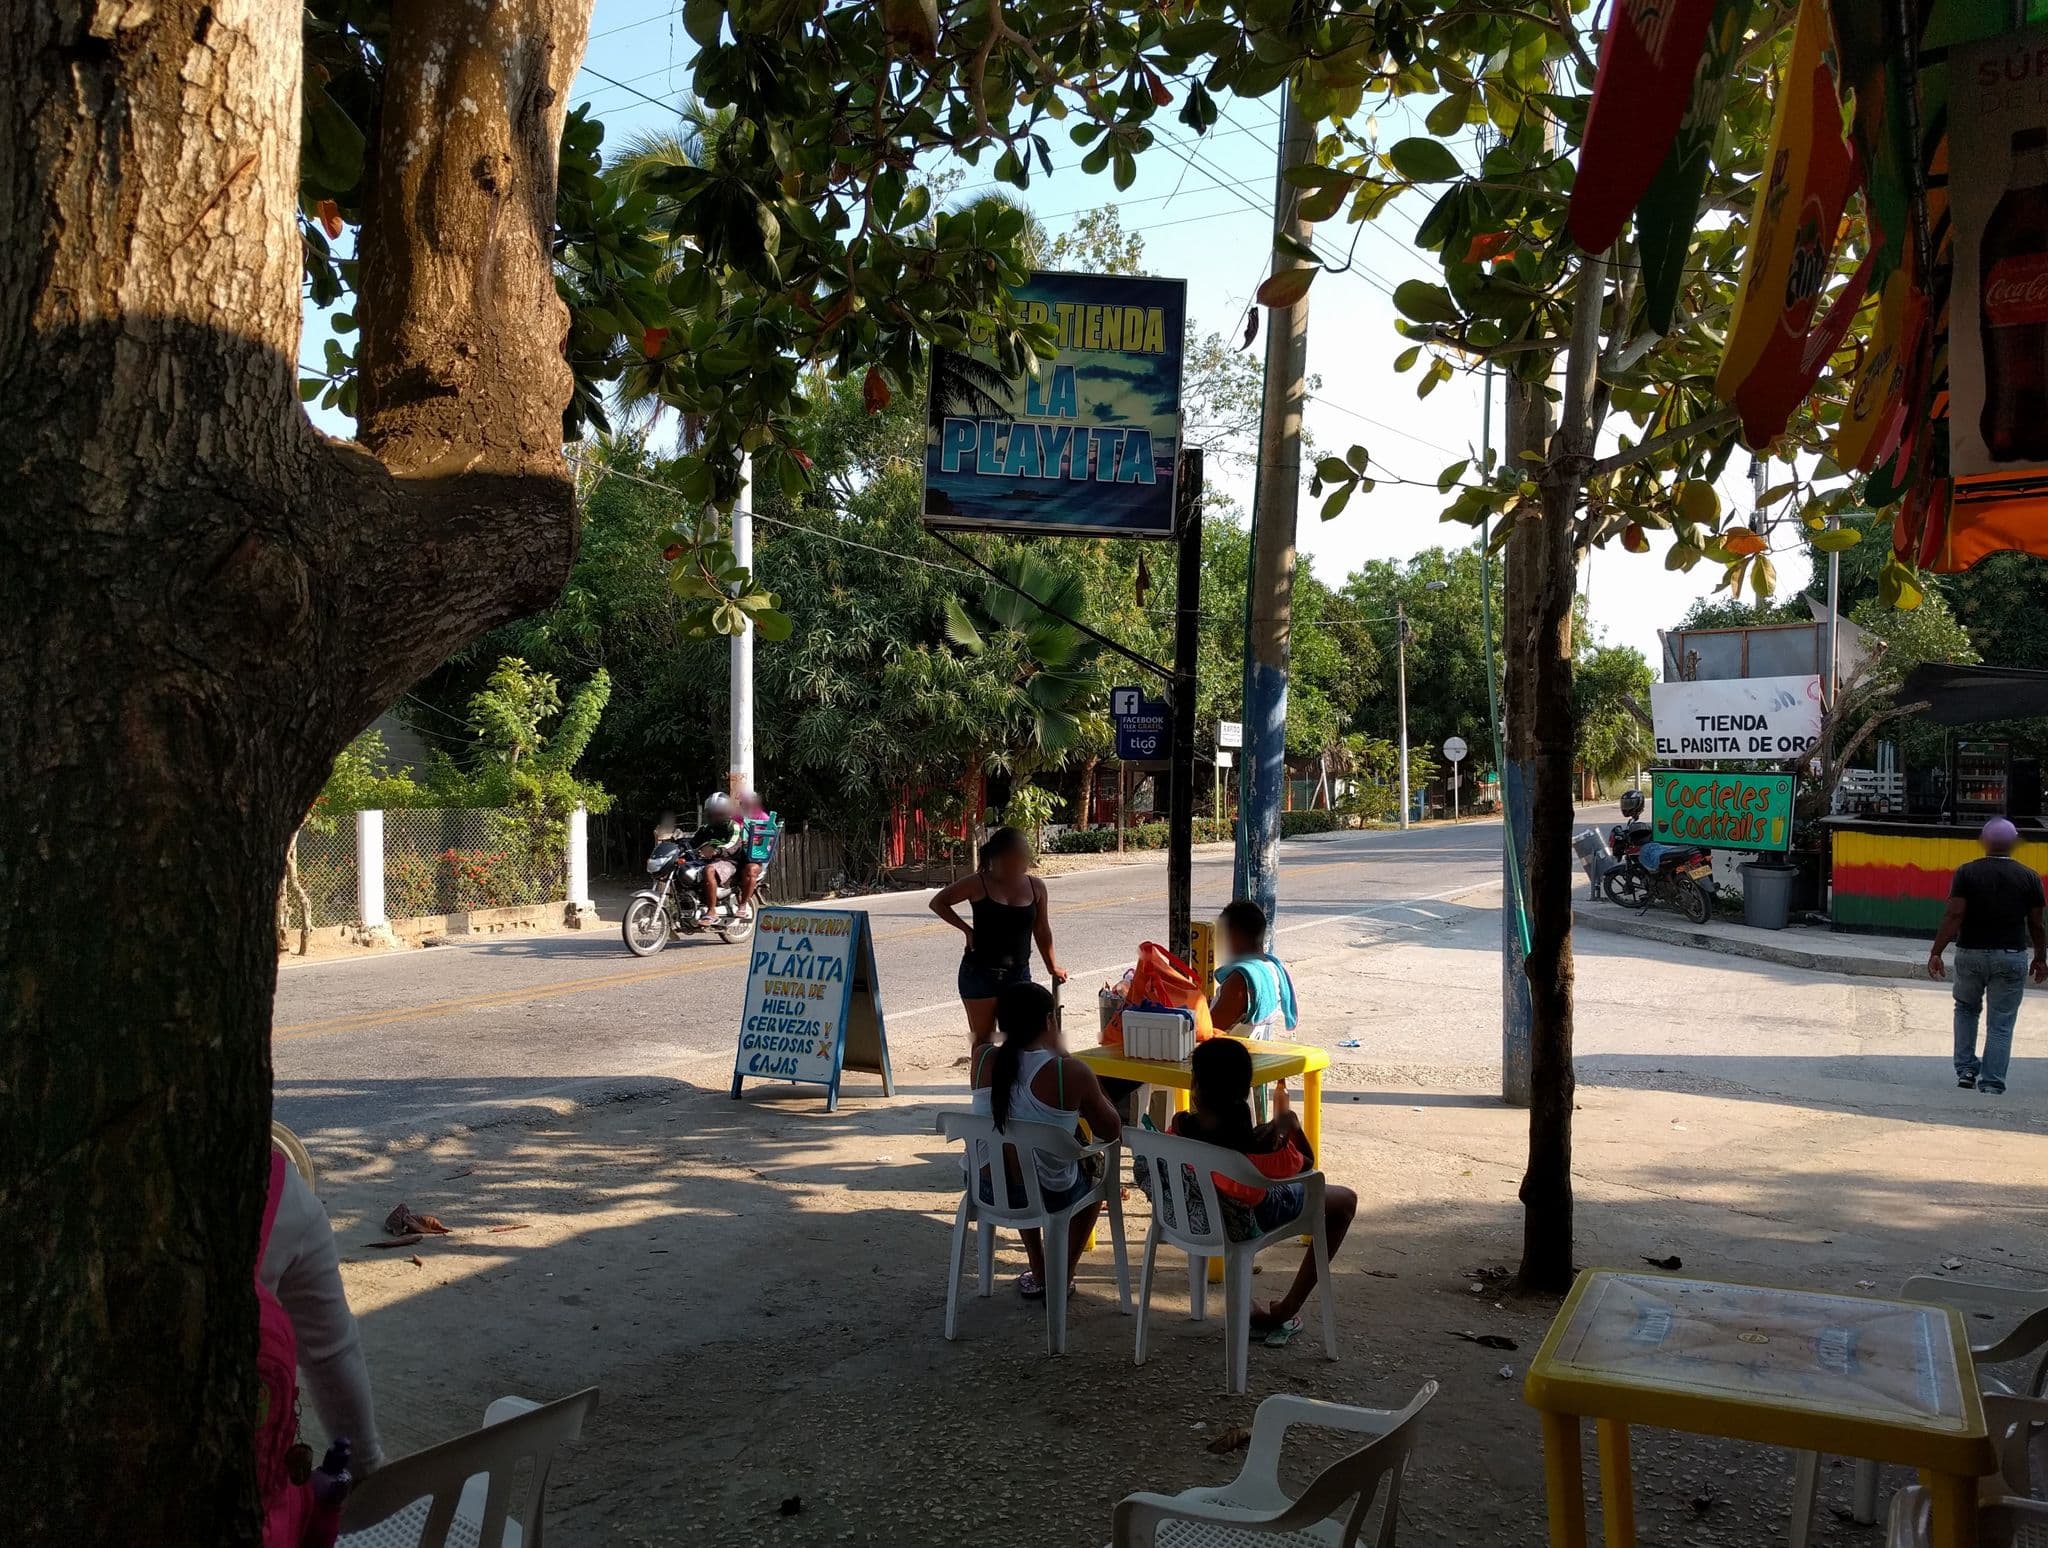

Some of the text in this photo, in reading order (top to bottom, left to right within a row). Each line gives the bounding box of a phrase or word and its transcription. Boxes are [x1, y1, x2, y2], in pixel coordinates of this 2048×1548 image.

[1055, 303, 1165, 354] TIENDA
[1025, 363, 1079, 419] LA
[941, 417, 1157, 485] PLAYITA
[1123, 716, 1164, 724] FACEBOOK
[1695, 714, 1768, 732] TIENDA
[1656, 738, 1678, 754] EL
[1681, 736, 1740, 754] PAISITA
[1749, 736, 1773, 753] DE
[1665, 778, 1770, 812] Cocteles
[1671, 808, 1768, 843] Cocktails
[777, 936, 813, 952] LA
[753, 952, 843, 983] PLAYITA
[764, 980, 827, 1000] VENTA DE
[761, 999, 806, 1016] HIELO
[747, 1016, 820, 1036] CERVEZAS
[743, 1034, 814, 1054] GASEOSAS
[749, 1053, 799, 1075] CAJAS
